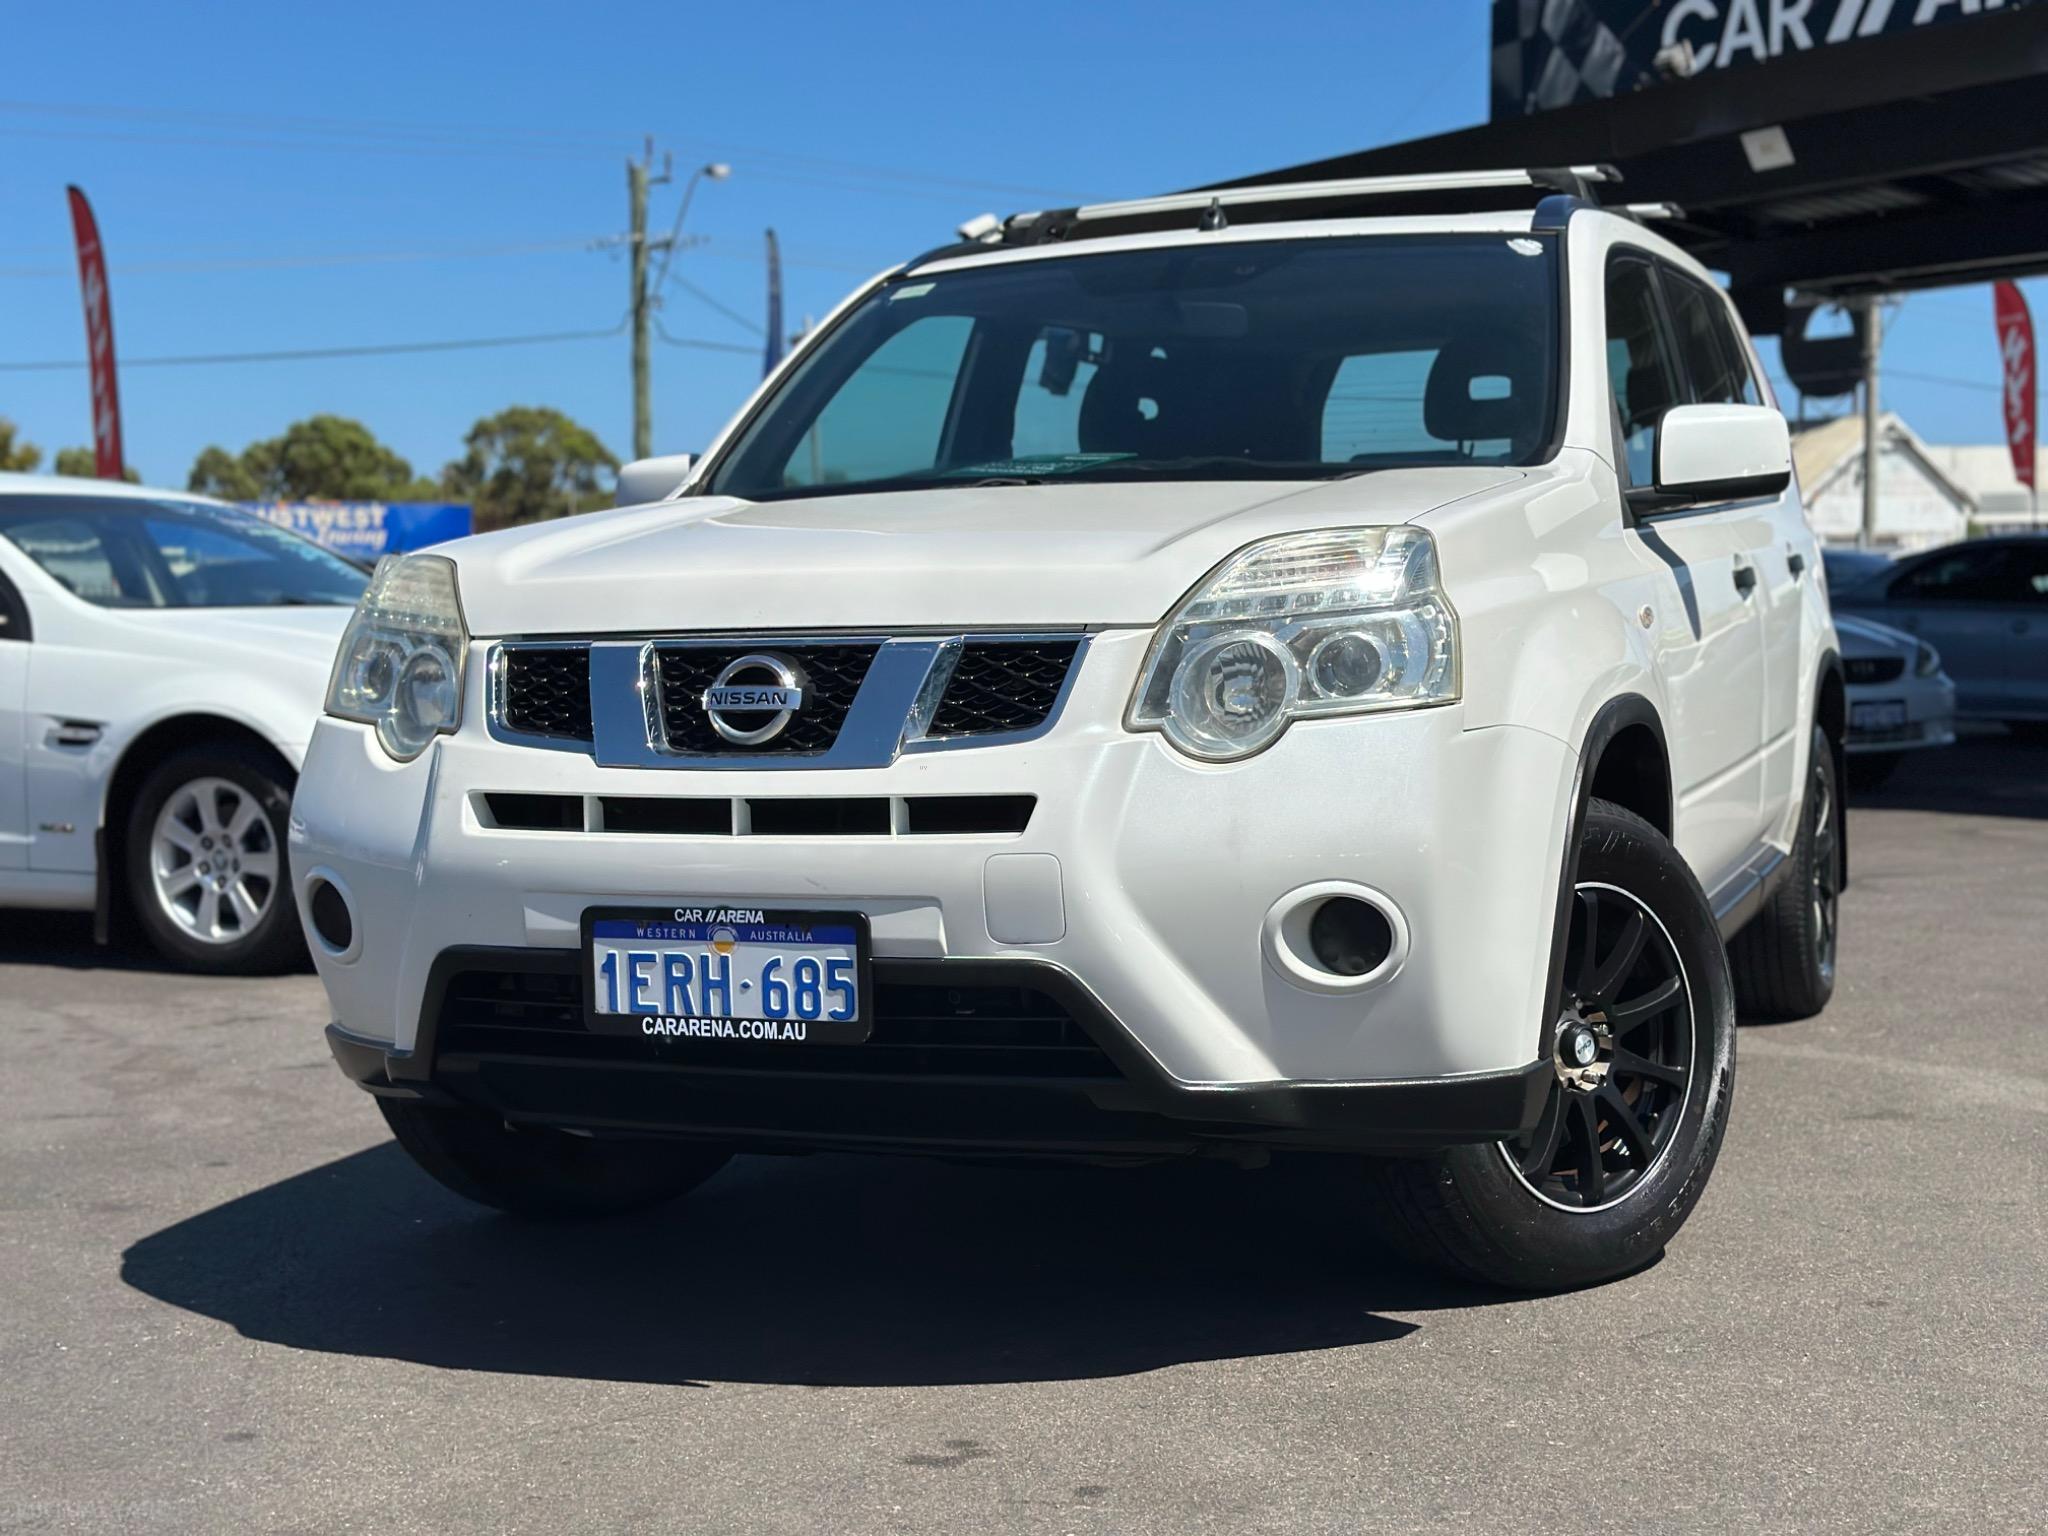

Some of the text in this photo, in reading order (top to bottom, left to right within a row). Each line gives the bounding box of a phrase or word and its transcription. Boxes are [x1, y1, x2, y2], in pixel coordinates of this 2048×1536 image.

[1661, 0, 1815, 77] CAR
[710, 691, 788, 706] NISSAN
[636, 927, 814, 942] WESTERN AUSTRALIA
[642, 1016, 807, 1041] CARARENA.COM.AU
